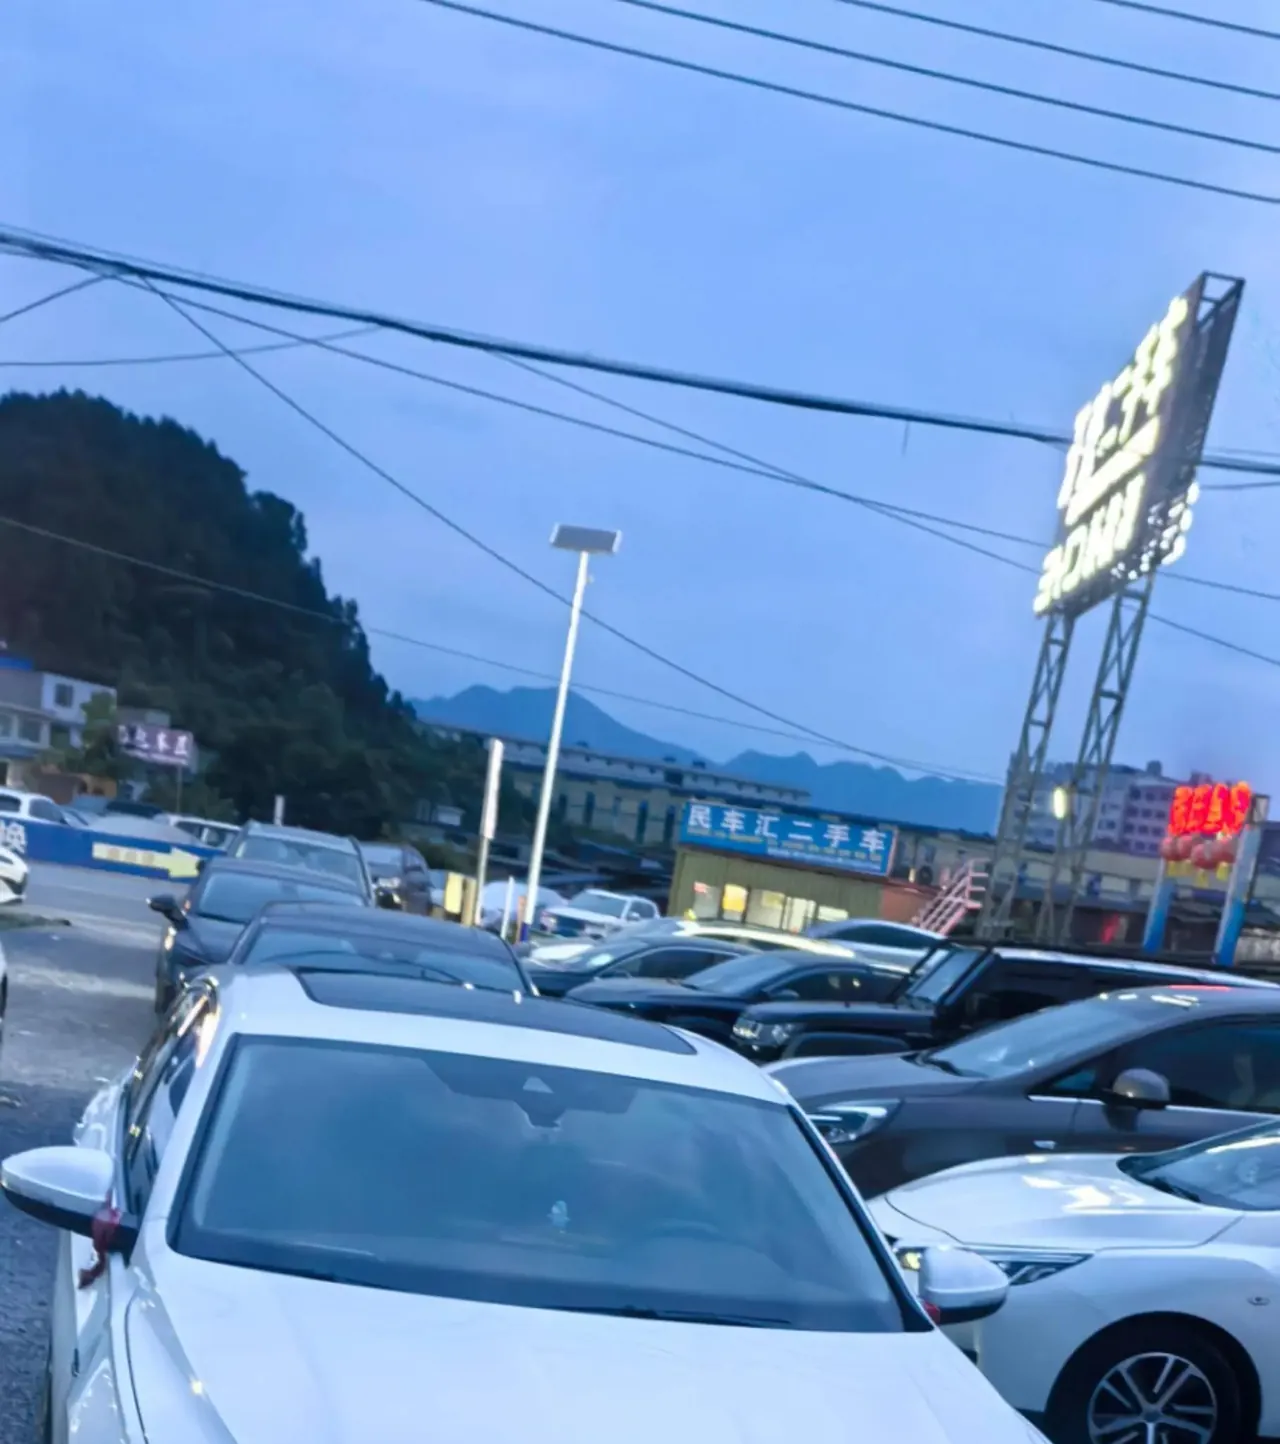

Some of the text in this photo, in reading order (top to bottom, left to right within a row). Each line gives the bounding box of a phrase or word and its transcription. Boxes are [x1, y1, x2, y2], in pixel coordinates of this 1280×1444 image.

[688, 804, 887, 852] 民车汇二手车
